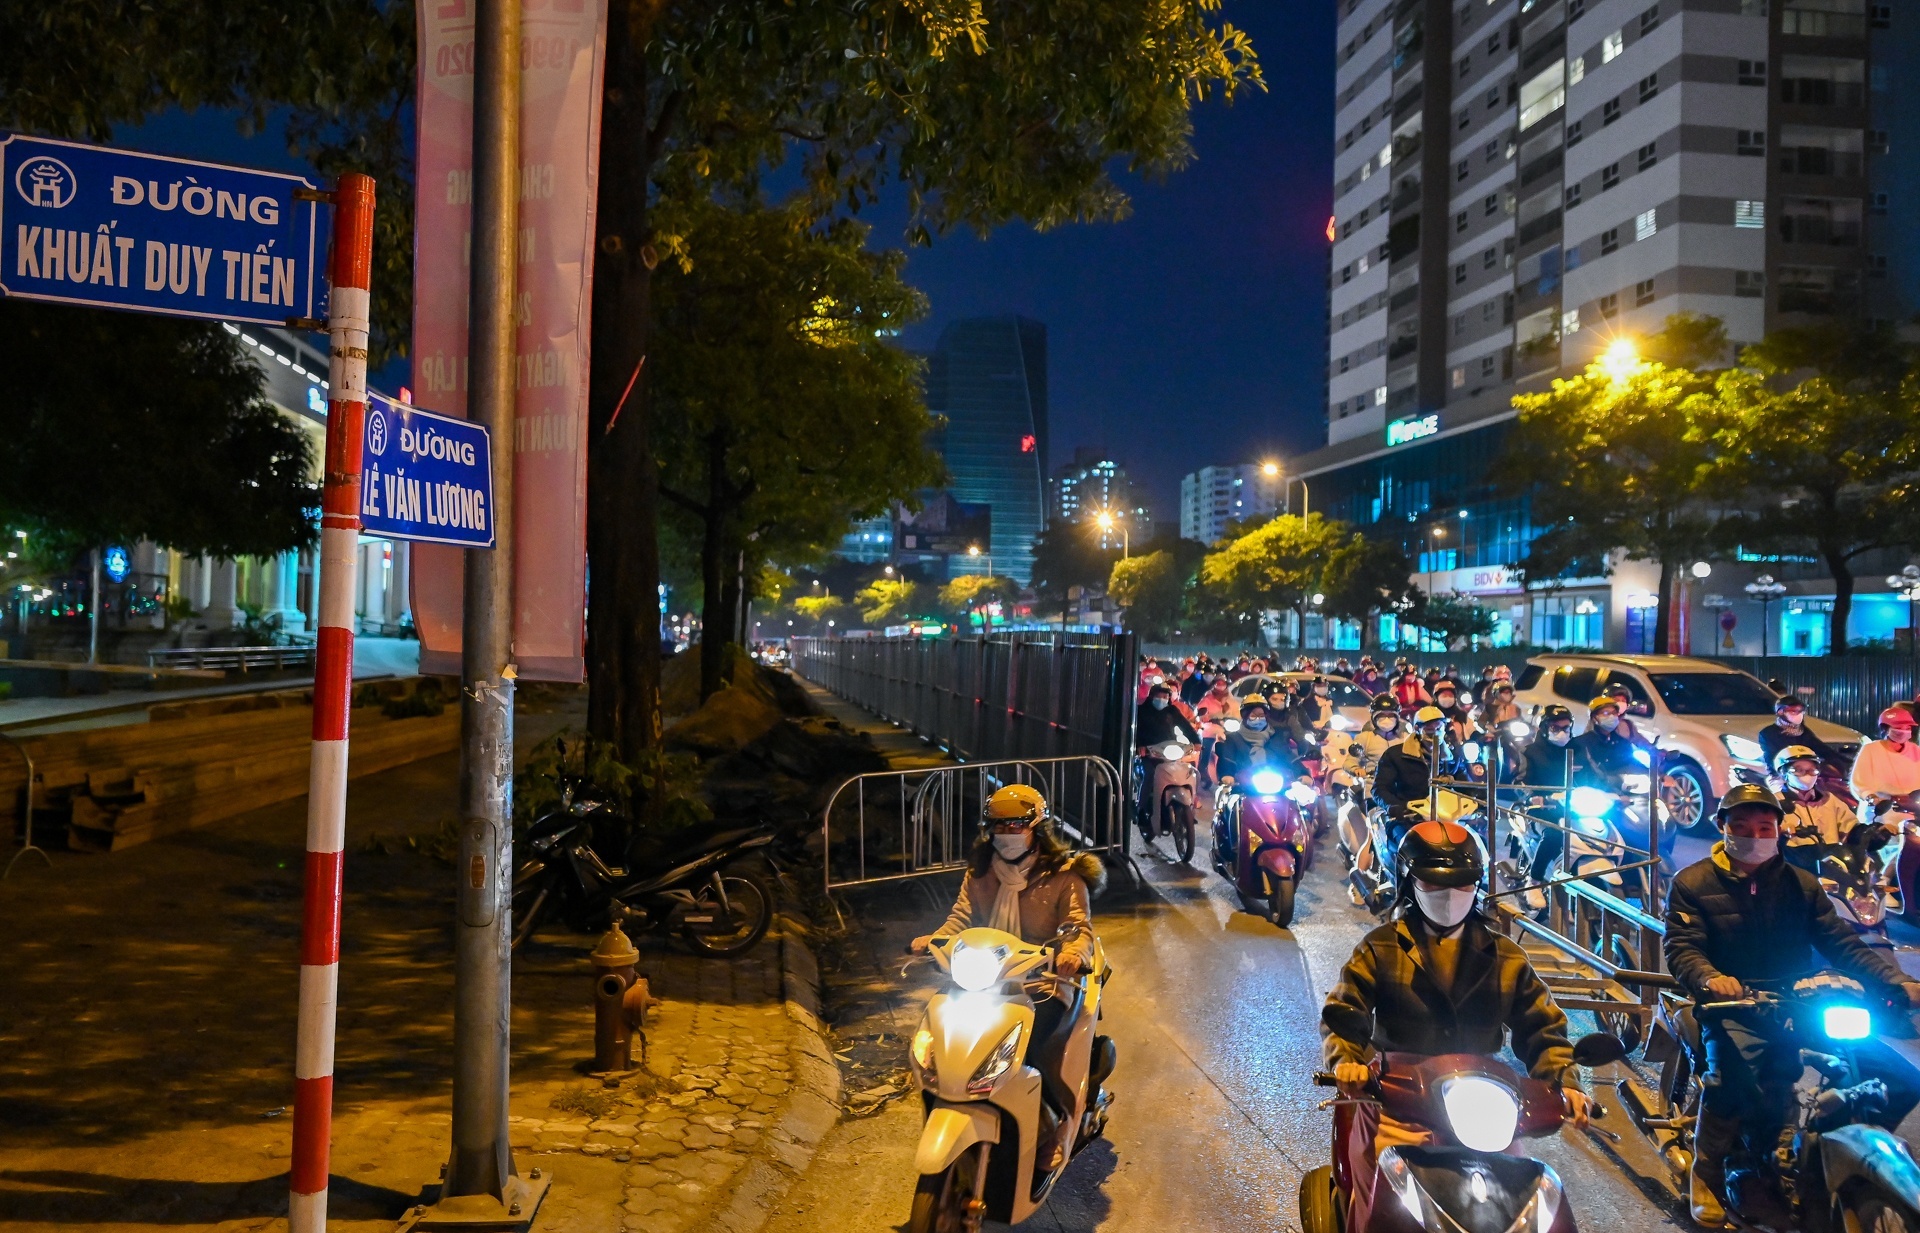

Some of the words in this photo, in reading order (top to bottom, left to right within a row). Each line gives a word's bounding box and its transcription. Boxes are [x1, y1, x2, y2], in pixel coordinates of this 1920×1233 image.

[110, 175, 279, 225] ĐƯỜNG
[17, 220, 134, 288] KHUẤT
[145, 240, 212, 297] DUY
[222, 239, 295, 307] TIẾN
[400, 427, 475, 466] ĐƯỜNG
[362, 462, 380, 517] LÊ
[384, 467, 422, 523] VĂN
[425, 480, 486, 531] LƯƠNG
[1474, 572, 1495, 586] BIDV
